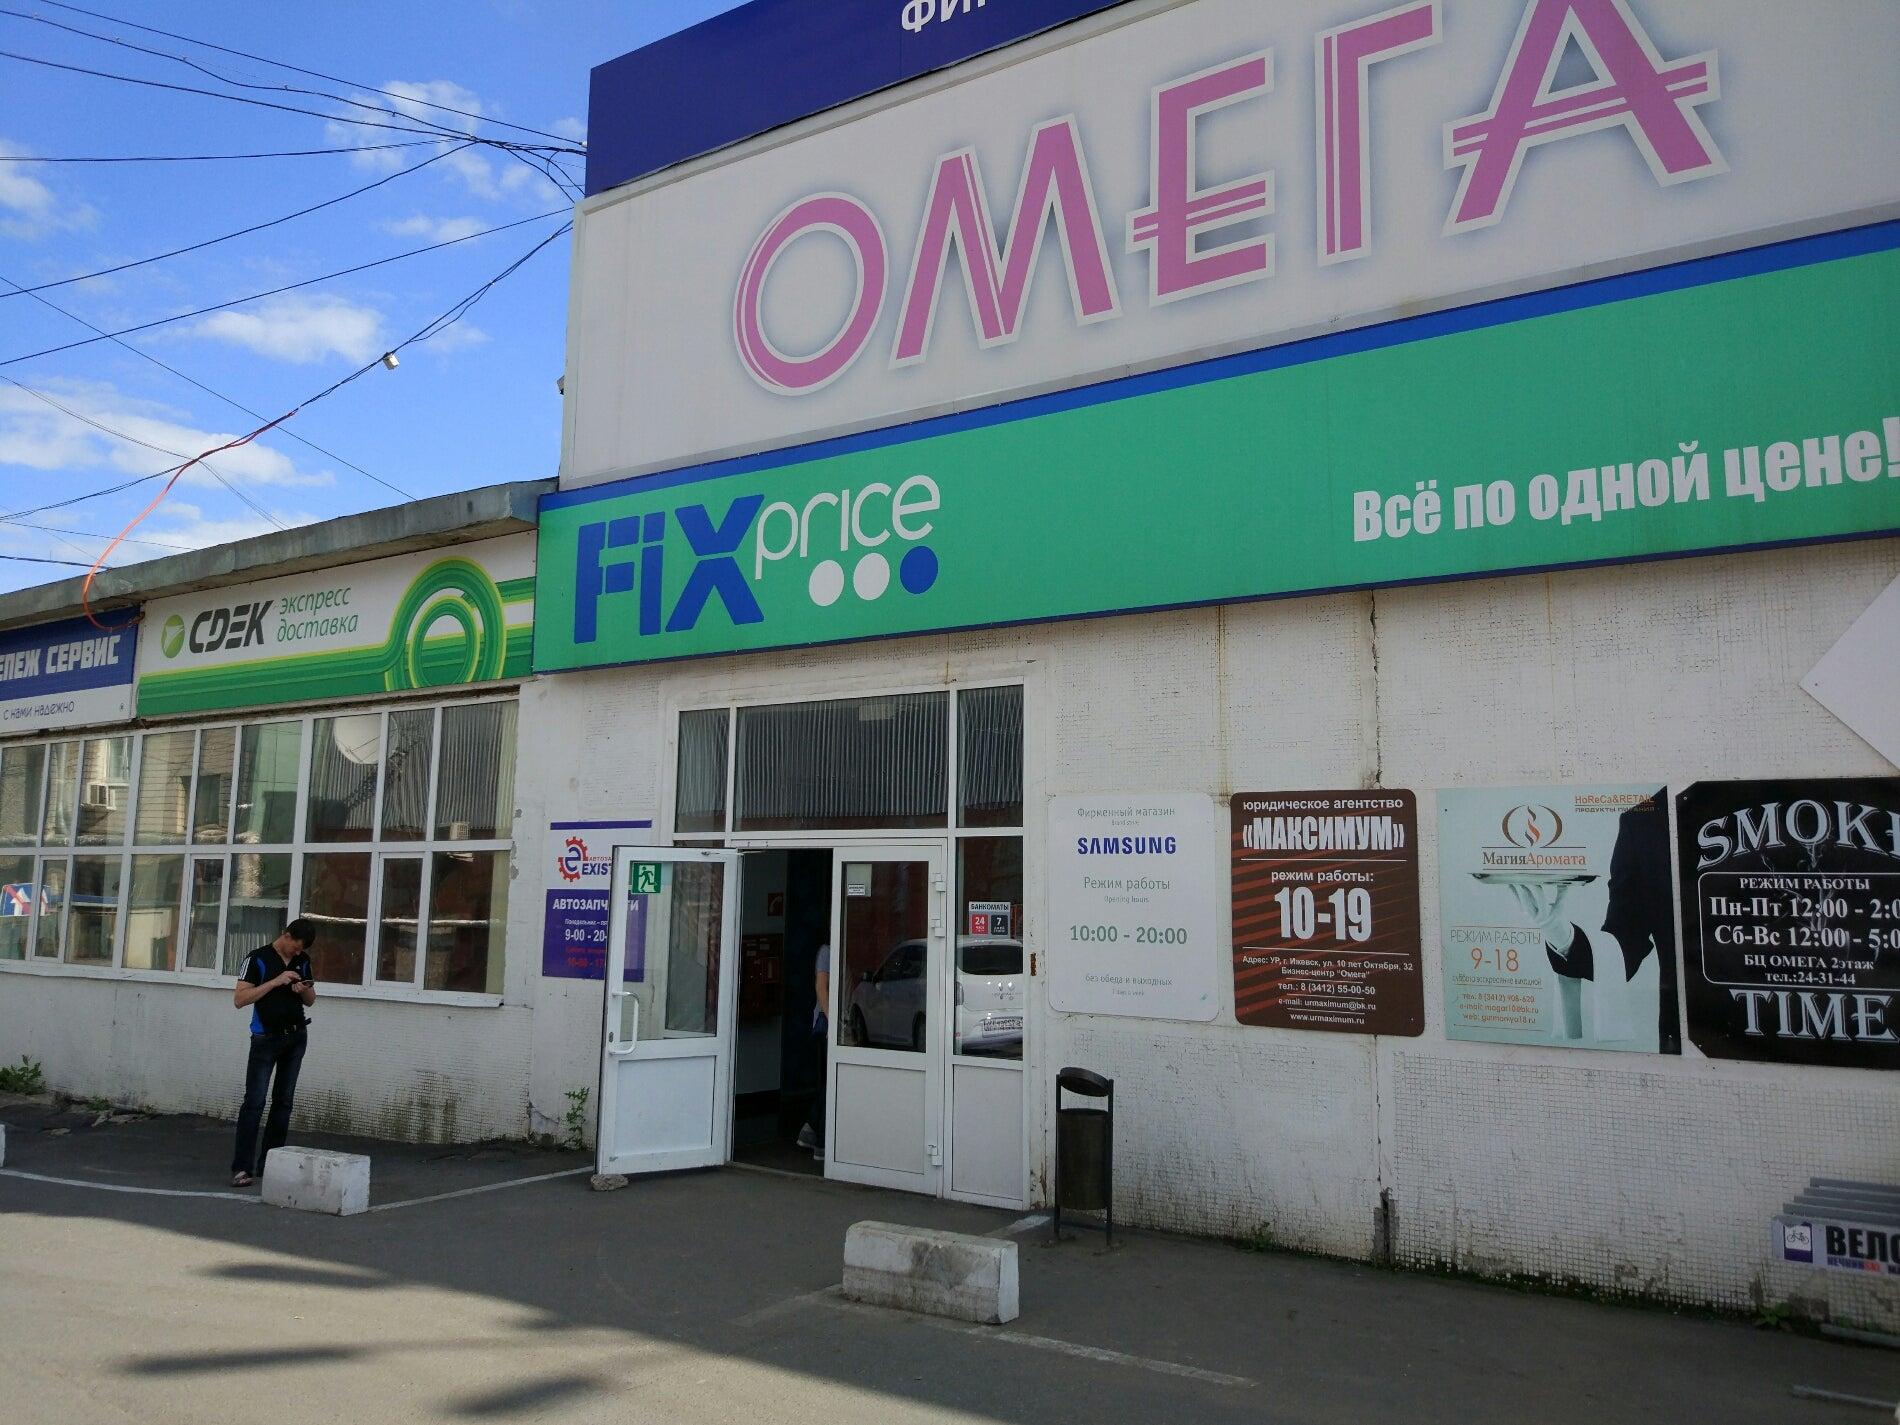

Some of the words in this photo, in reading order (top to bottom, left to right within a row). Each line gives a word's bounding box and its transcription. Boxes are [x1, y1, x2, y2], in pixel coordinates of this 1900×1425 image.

[735, 0, 1726, 392] ОМЕГА
[1354, 481, 1441, 541] Всё
[1454, 480, 1516, 530] по
[1528, 441, 1709, 525] одной
[1724, 417, 1900, 502] цене!
[279, 588, 351, 615] экспресс
[277, 615, 358, 642] доставка
[46, 635, 120, 674] СЕРВИС
[1077, 806, 1133, 819] Фирменный
[1135, 808, 1176, 818] магазин
[1243, 799, 1330, 812] юридическое
[1333, 798, 1404, 812] агентство
[1242, 816, 1405, 850] «МАКСИМУМ»
[1077, 836, 1176, 855] SAMSUNG
[1084, 876, 1121, 889] Режим
[1126, 877, 1170, 892] работы
[1271, 870, 1314, 882] режим
[1317, 869, 1374, 883] работы:
[1740, 878, 1799, 889] РЕЖИМ
[1804, 878, 1870, 890] РАБОТЫ
[1274, 886, 1372, 942] 10-19
[1709, 897, 1782, 916] Пн-Пт
[1790, 898, 1848, 918] 12:00
[975, 916, 985, 925] 24
[996, 917, 1002, 926] 7
[565, 929, 585, 941] 9-00
[1070, 925, 1118, 942] 10:00
[1136, 926, 1188, 944] 20:00
[1450, 929, 1494, 944] РЕЖИМ
[1495, 929, 1541, 945] РАБОТЫ
[1714, 924, 1781, 945] Сб-Вс
[1788, 927, 1847, 948] 12:00
[1243, 955, 1268, 964] Адрес:
[1270, 956, 1281, 965] УР,
[1290, 957, 1321, 967] Ижевск,
[1322, 959, 1334, 967] ул.
[1348, 961, 1361, 969] лет
[1364, 961, 1401, 971] Октября,
[1471, 948, 1519, 972] 9-18
[1744, 954, 1766, 967] БЦ
[1769, 955, 1827, 968] ОМЕГА
[1831, 957, 1874, 970] 2этаж
[1281, 967, 1335, 978] Бизнес-центр
[1301, 982, 1306, 991] 8
[1308, 983, 1335, 993] (3412)
[1337, 984, 1376, 995] 55-00-50
[1278, 998, 1302, 1006] e-mail:
[1290, 1013, 1365, 1024] www.urmaximum.ru
[1729, 988, 1900, 1042] TIME
